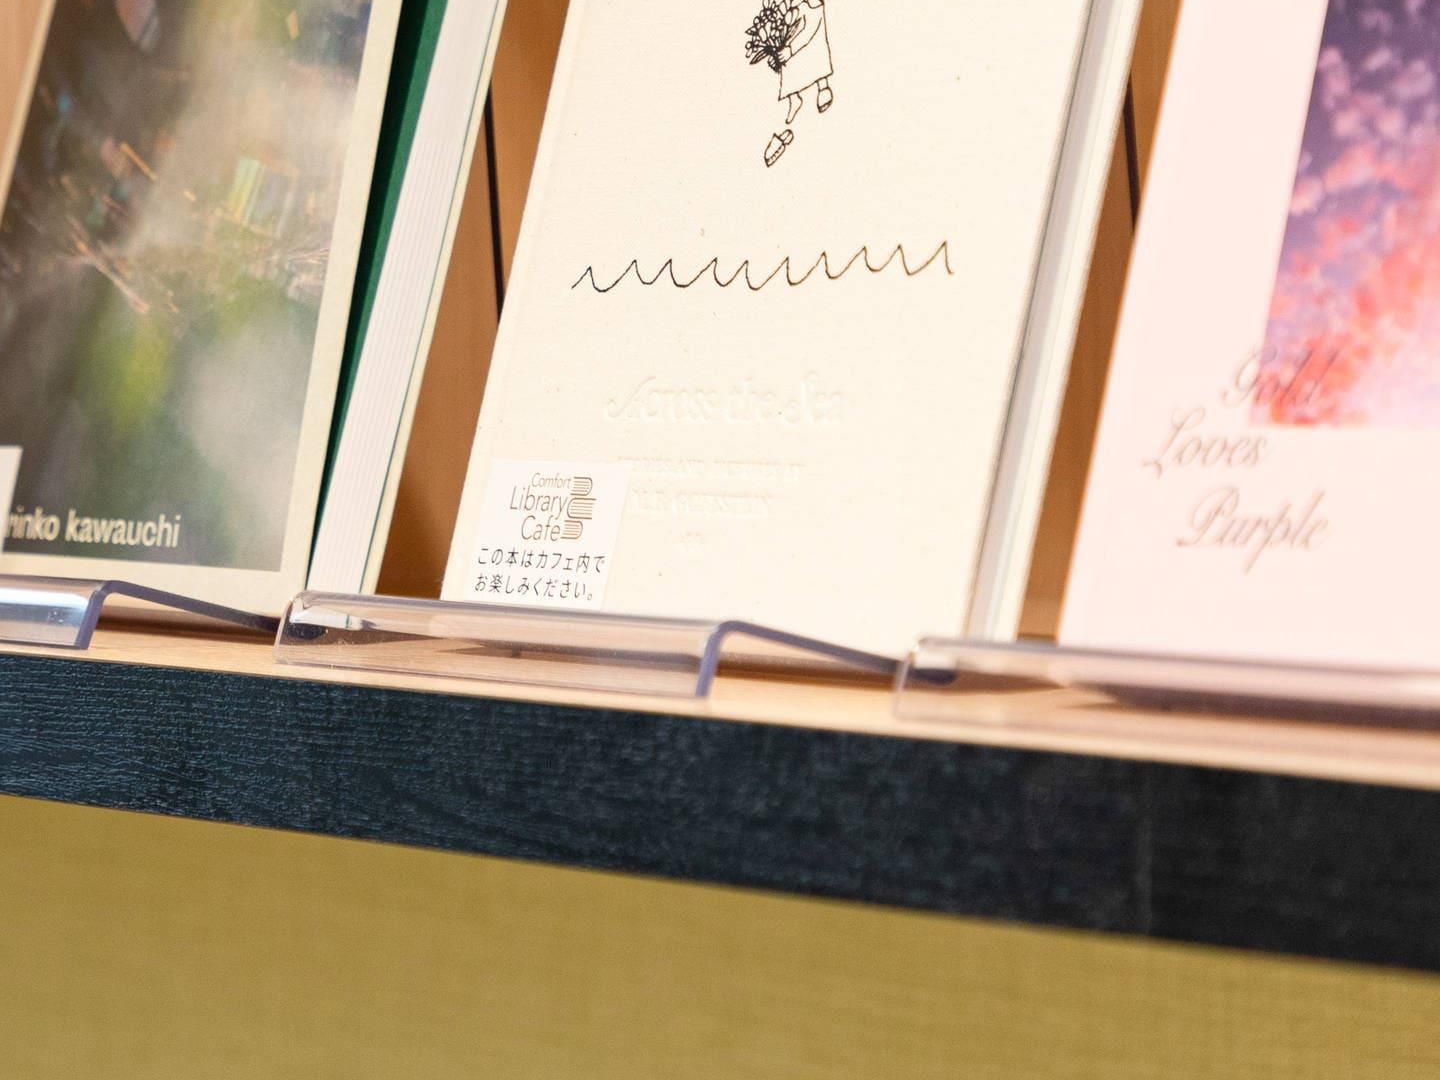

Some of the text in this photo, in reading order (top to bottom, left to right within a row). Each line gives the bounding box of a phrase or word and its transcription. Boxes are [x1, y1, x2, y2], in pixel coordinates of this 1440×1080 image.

[1141, 407, 1268, 479] Loves
[531, 472, 571, 489] Comfort
[509, 484, 568, 520] Library
[64, 507, 182, 549] kawauchi
[520, 514, 561, 542] Cafe
[1175, 485, 1330, 576] Purple
[477, 546, 606, 574] この本はカフェ内で
[474, 572, 594, 601] お楽しみください。
